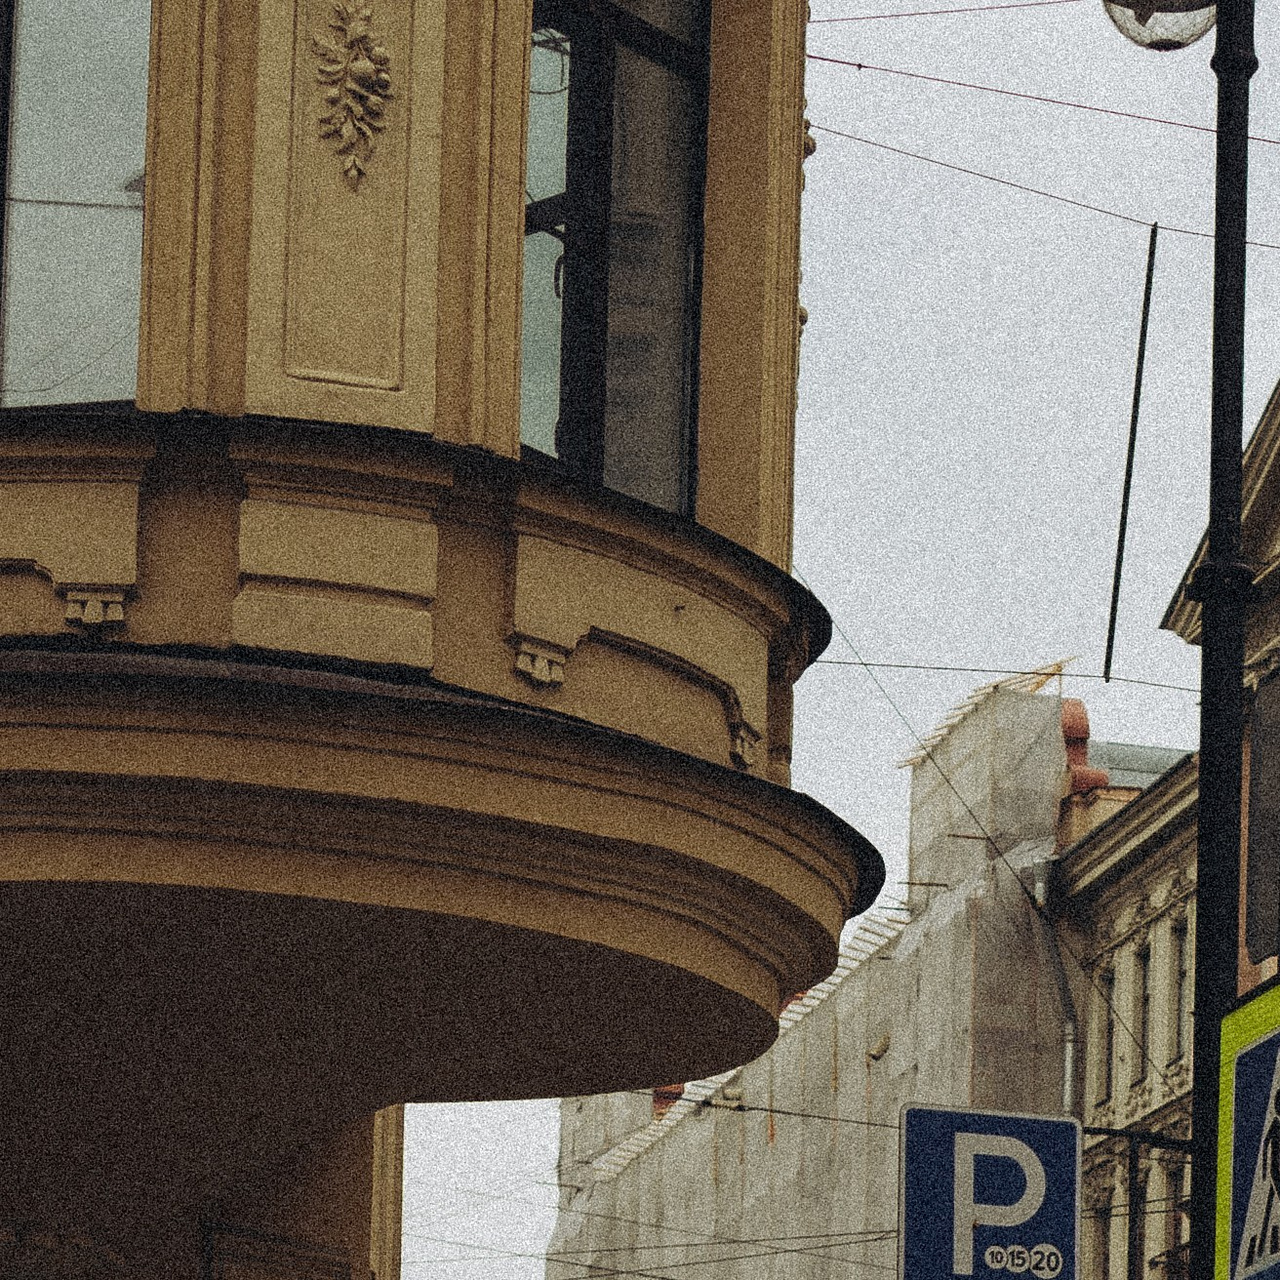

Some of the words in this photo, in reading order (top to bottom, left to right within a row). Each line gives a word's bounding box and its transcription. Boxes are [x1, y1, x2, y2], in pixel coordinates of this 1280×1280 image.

[953, 1132, 1046, 1276] P
[989, 1249, 1004, 1264] 10
[1009, 1247, 1026, 1268] 15
[1032, 1249, 1060, 1272] 20
